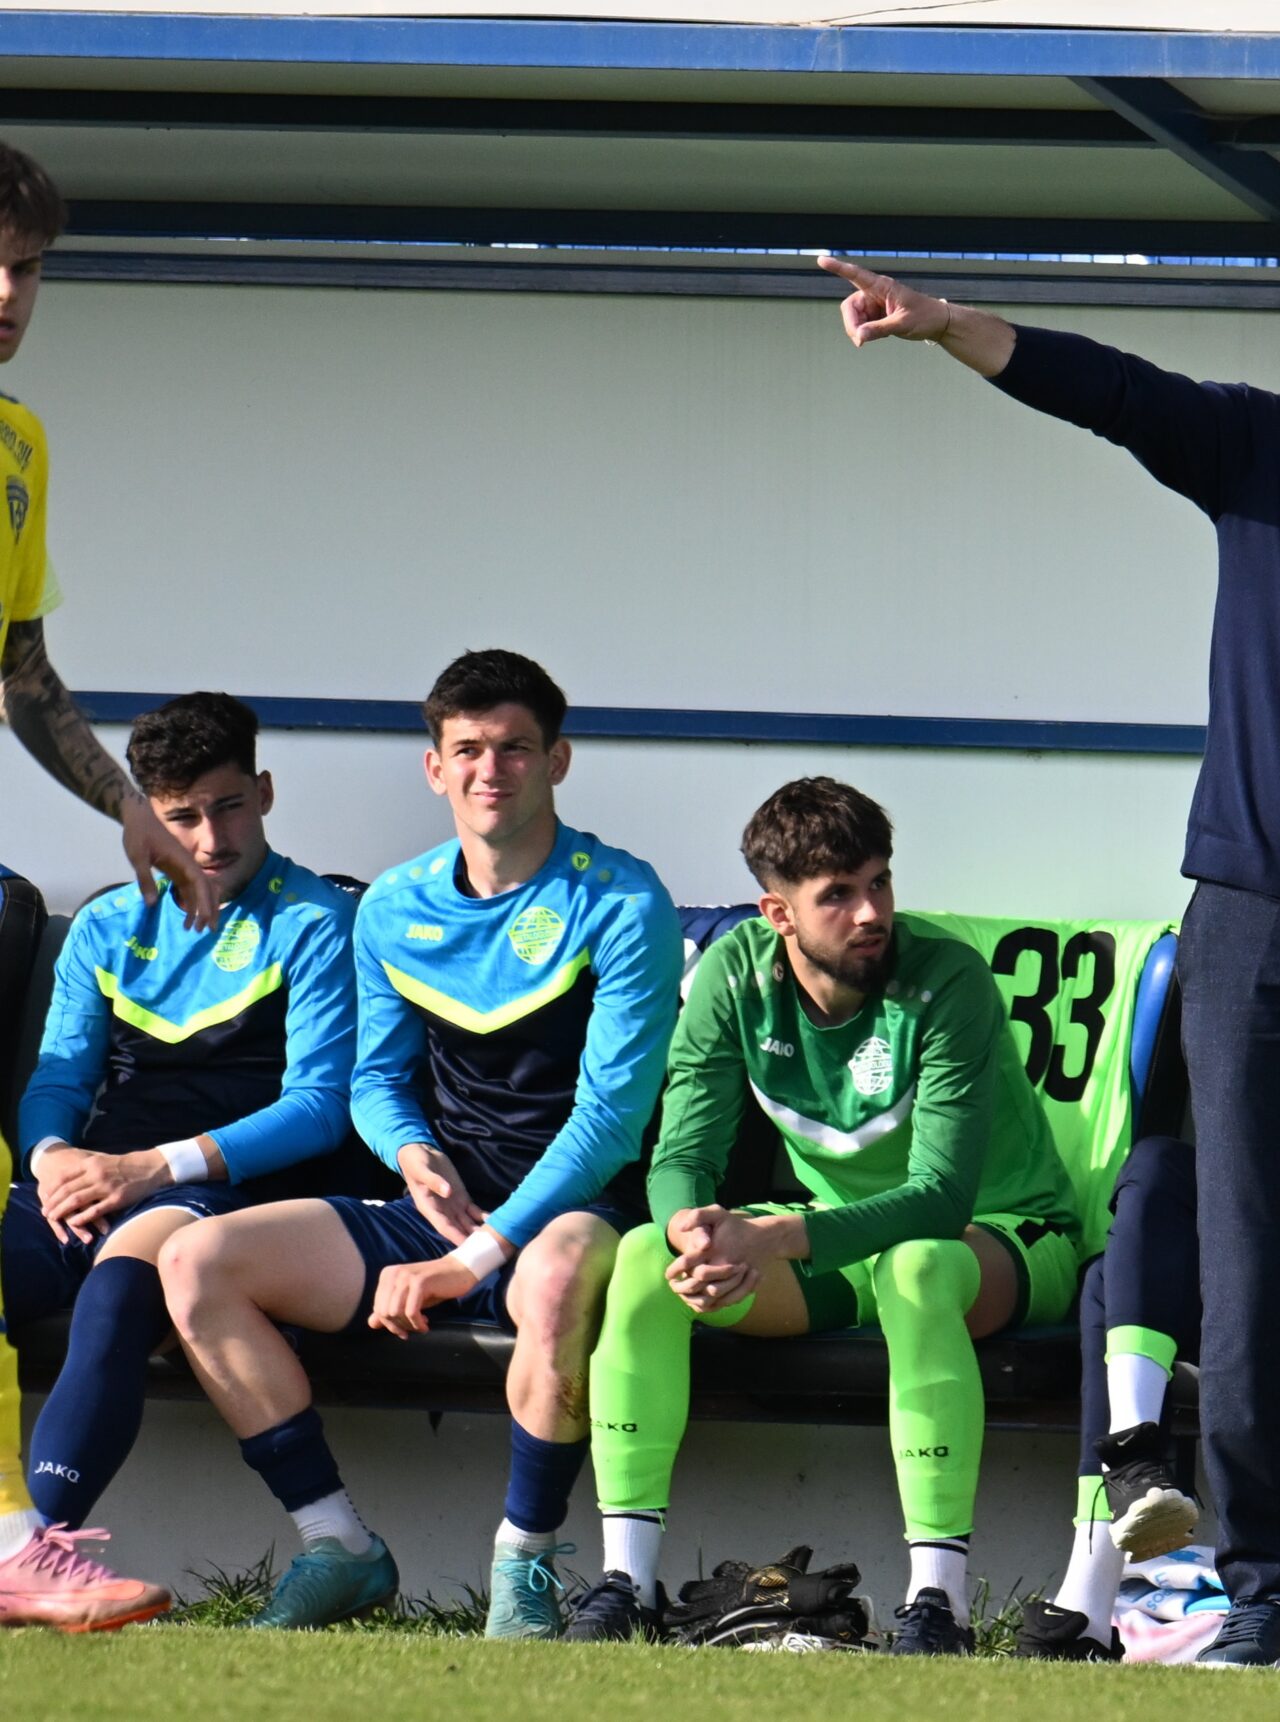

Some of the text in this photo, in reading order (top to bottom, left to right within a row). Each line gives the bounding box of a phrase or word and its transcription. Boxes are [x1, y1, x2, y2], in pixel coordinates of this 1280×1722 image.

[405, 924, 443, 942] JAKO
[990, 926, 1117, 1103] 33
[34, 1461, 80, 1483] JAKO
